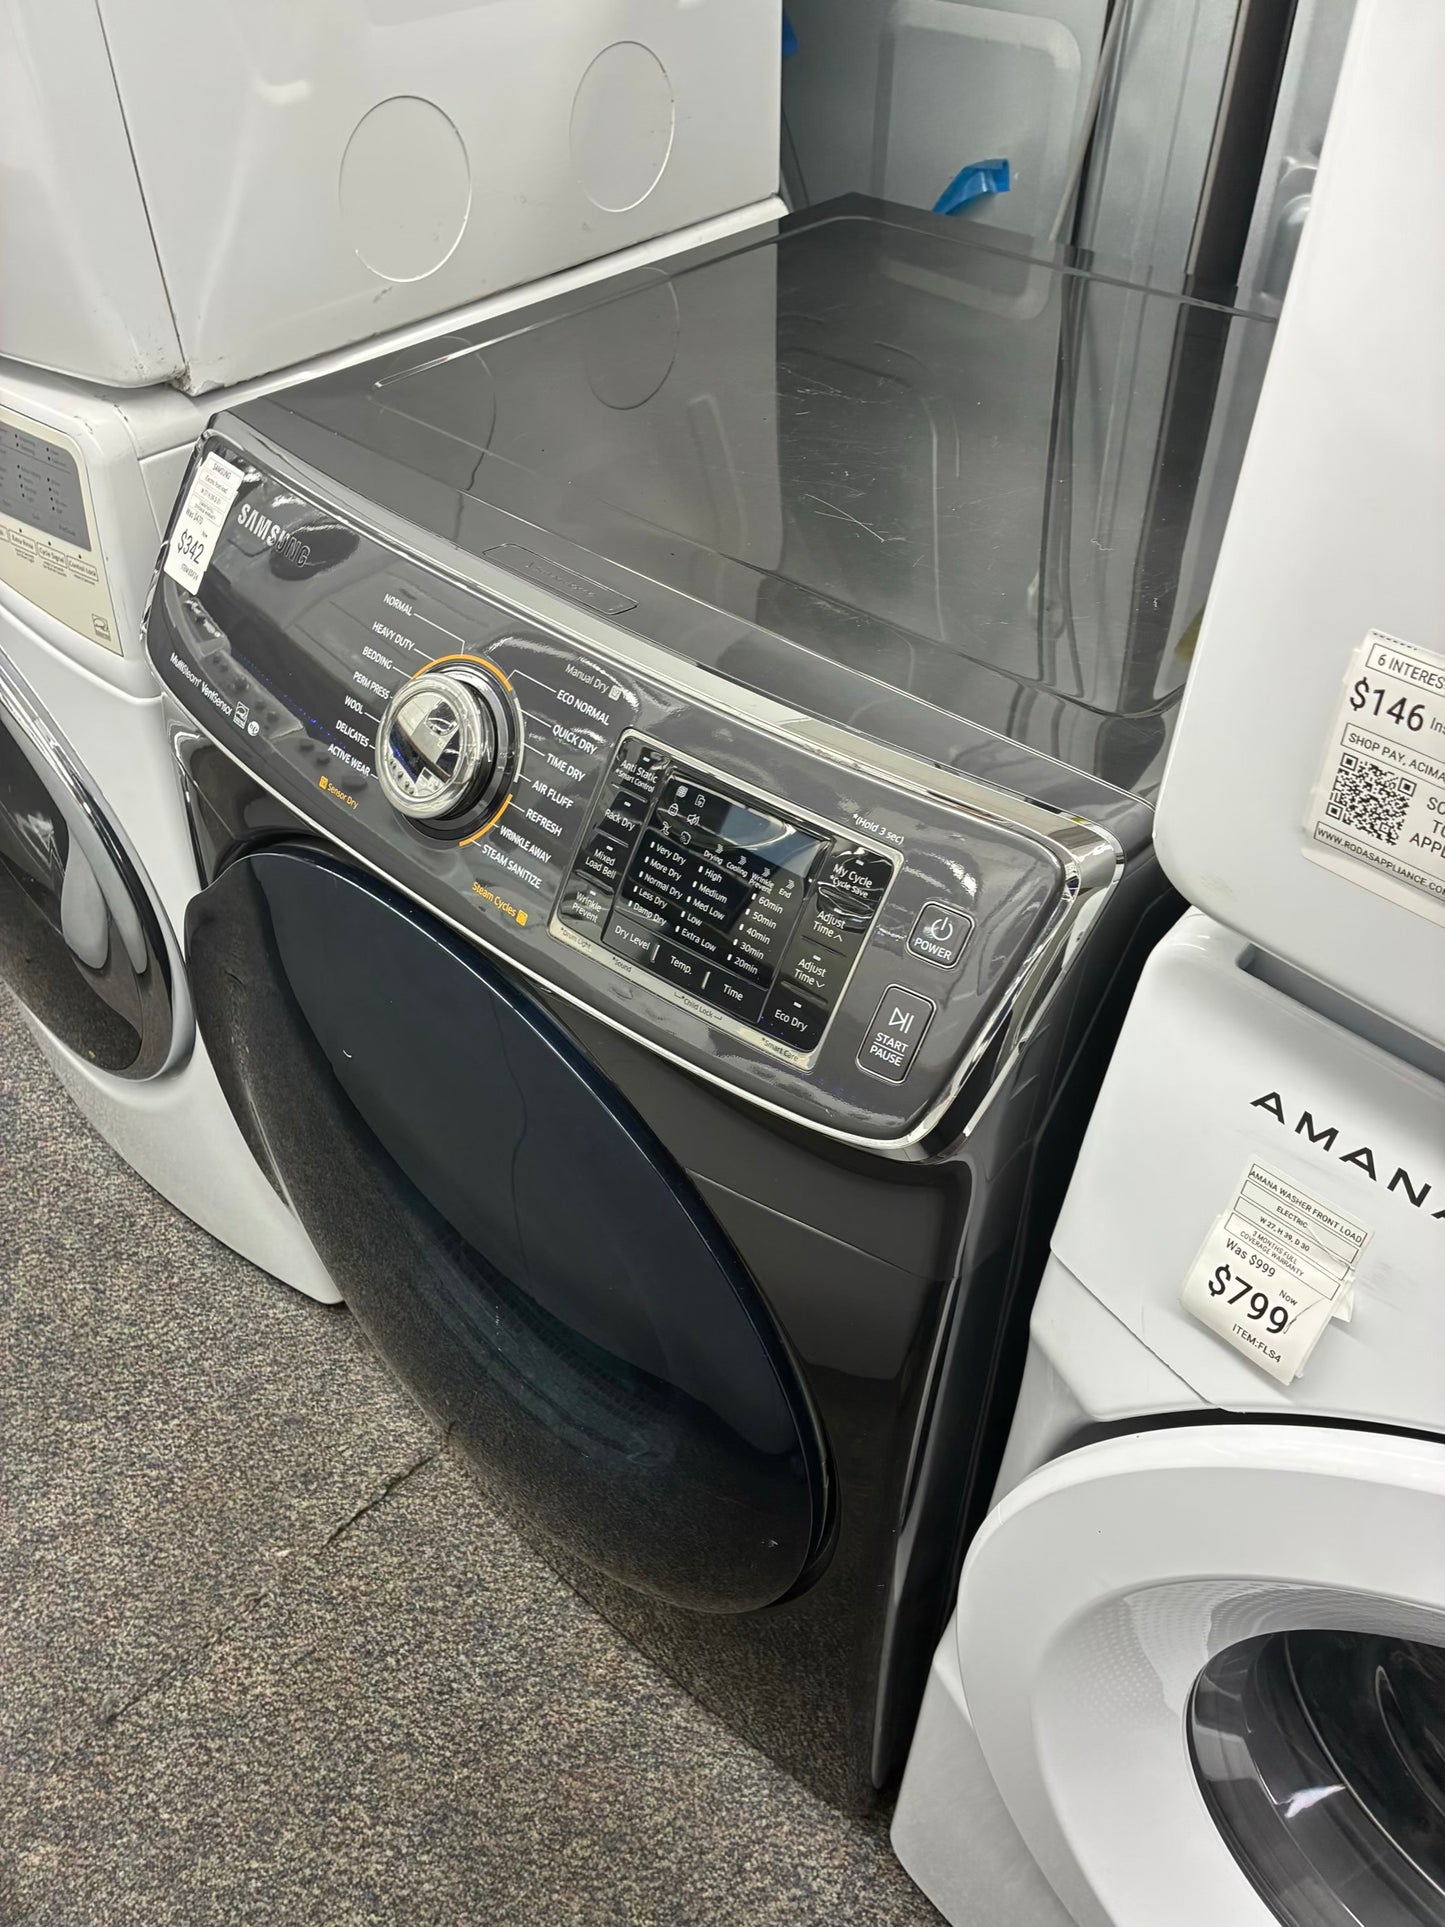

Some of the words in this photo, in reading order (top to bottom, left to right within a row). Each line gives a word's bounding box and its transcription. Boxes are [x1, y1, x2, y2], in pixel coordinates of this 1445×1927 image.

[178, 528, 205, 565] $342
[238, 503, 311, 568] SAMSUNG
[383, 593, 414, 616] NORMAL
[371, 621, 397, 639] HEAVY
[394, 634, 415, 651] DUTY
[362, 646, 393, 670] BEDDING
[1377, 654, 1387, 666] 6
[352, 671, 371, 690] PERM
[369, 682, 391, 700] PRESS
[565, 663, 595, 685] Manual
[593, 679, 609, 694] Dry
[344, 695, 364, 715] WOOL
[556, 689, 575, 705] ECO
[573, 699, 610, 726] NORMAL
[1349, 676, 1425, 731] $146
[335, 720, 370, 748] DELICATES
[552, 724, 580, 745] QUICK
[578, 738, 598, 755] DRY
[1348, 732, 1380, 751] SHOP
[327, 743, 351, 765] ACTIVE
[349, 758, 372, 777] WEAR
[546, 752, 567, 773] TIME
[566, 765, 586, 782] DRY
[621, 760, 638, 773] Anti
[636, 768, 658, 784] Static
[327, 782, 347, 801] Sensor
[345, 794, 359, 810] Dry
[531, 780, 548, 797] AIR
[546, 788, 574, 809] FLUFF
[634, 778, 655, 793] Control
[525, 808, 563, 837] REFRESH
[604, 808, 622, 824] Rack
[621, 817, 636, 831] Dry
[500, 825, 530, 850] WRINKLE
[528, 841, 552, 864] AWAY
[879, 826, 887, 835] 3
[886, 830, 905, 845] sec)
[594, 849, 616, 866] Mixed
[656, 843, 673, 859] Very
[672, 852, 687, 866] Dry
[703, 849, 724, 865] Drying
[481, 844, 508, 866] STEAM
[506, 859, 543, 889] SANITIZE
[585, 856, 602, 872] Load
[602, 866, 617, 880] Bell
[649, 859, 668, 874] More
[668, 868, 682, 881] Dry
[704, 868, 722, 883] High
[726, 861, 748, 878] Cooling
[832, 863, 848, 878] My
[848, 870, 873, 889] Cycle
[643, 873, 669, 891] Normal
[669, 886, 683, 900] Dry
[748, 879, 772, 895] Prevent
[751, 872, 775, 889] Wrinkle
[471, 881, 495, 902] Steam
[493, 896, 517, 917] Cycles
[576, 891, 602, 913] Wrinkle
[638, 888, 654, 902] Less
[653, 896, 668, 909] Dry
[698, 883, 728, 904] Medium
[758, 896, 783, 914] 60min
[778, 888, 792, 899] End
[571, 902, 598, 923] Prevent
[633, 902, 653, 918] Damp
[653, 913, 667, 927] Dry
[687, 913, 703, 927] Low
[692, 898, 710, 912] Med
[709, 907, 726, 921] Low
[752, 911, 777, 929] 50min
[816, 910, 846, 929] Adjust
[614, 925, 630, 940] Dry
[630, 933, 651, 950] Level
[681, 928, 701, 944] Extra
[700, 938, 717, 952] Low
[746, 927, 770, 945] 40min
[813, 920, 834, 938] Time
[740, 941, 764, 960] 30min
[914, 937, 953, 960] POWER
[670, 955, 692, 975] Temp.
[734, 956, 758, 975] 20min
[797, 958, 827, 978] Adjust
[794, 969, 815, 986] Time
[723, 983, 743, 1001] Time
[699, 1004, 713, 1019] Lock
[774, 1009, 790, 1023] Eco
[790, 1017, 808, 1032] Dry
[875, 1032, 909, 1053] START
[783, 1049, 799, 1062] Care
[869, 1046, 903, 1067] PAUSE
[1249, 1170, 1278, 1192] AMANA
[1279, 1187, 1312, 1213] WASHER
[1312, 1208, 1340, 1229] FRONT
[1339, 1225, 1362, 1243] LOAD
[1276, 1205, 1309, 1229] ELECTRIC
[1260, 1216, 1268, 1224] W
[1277, 1227, 1284, 1235] H
[1294, 1238, 1300, 1246] D
[1300, 1242, 1310, 1252] 30
[1226, 1237, 1248, 1259] Was
[1248, 1254, 1276, 1277] $999
[1240, 1230, 1272, 1255] COVERAGE
[1271, 1251, 1305, 1276] WARRANTY
[1257, 1234, 1284, 1254] MONTHS
[1283, 1251, 1298, 1265] FULL
[1208, 1263, 1289, 1334] $799
[1279, 1289, 1298, 1307] Now
[1232, 1323, 1282, 1363] ITEM:FLS4
